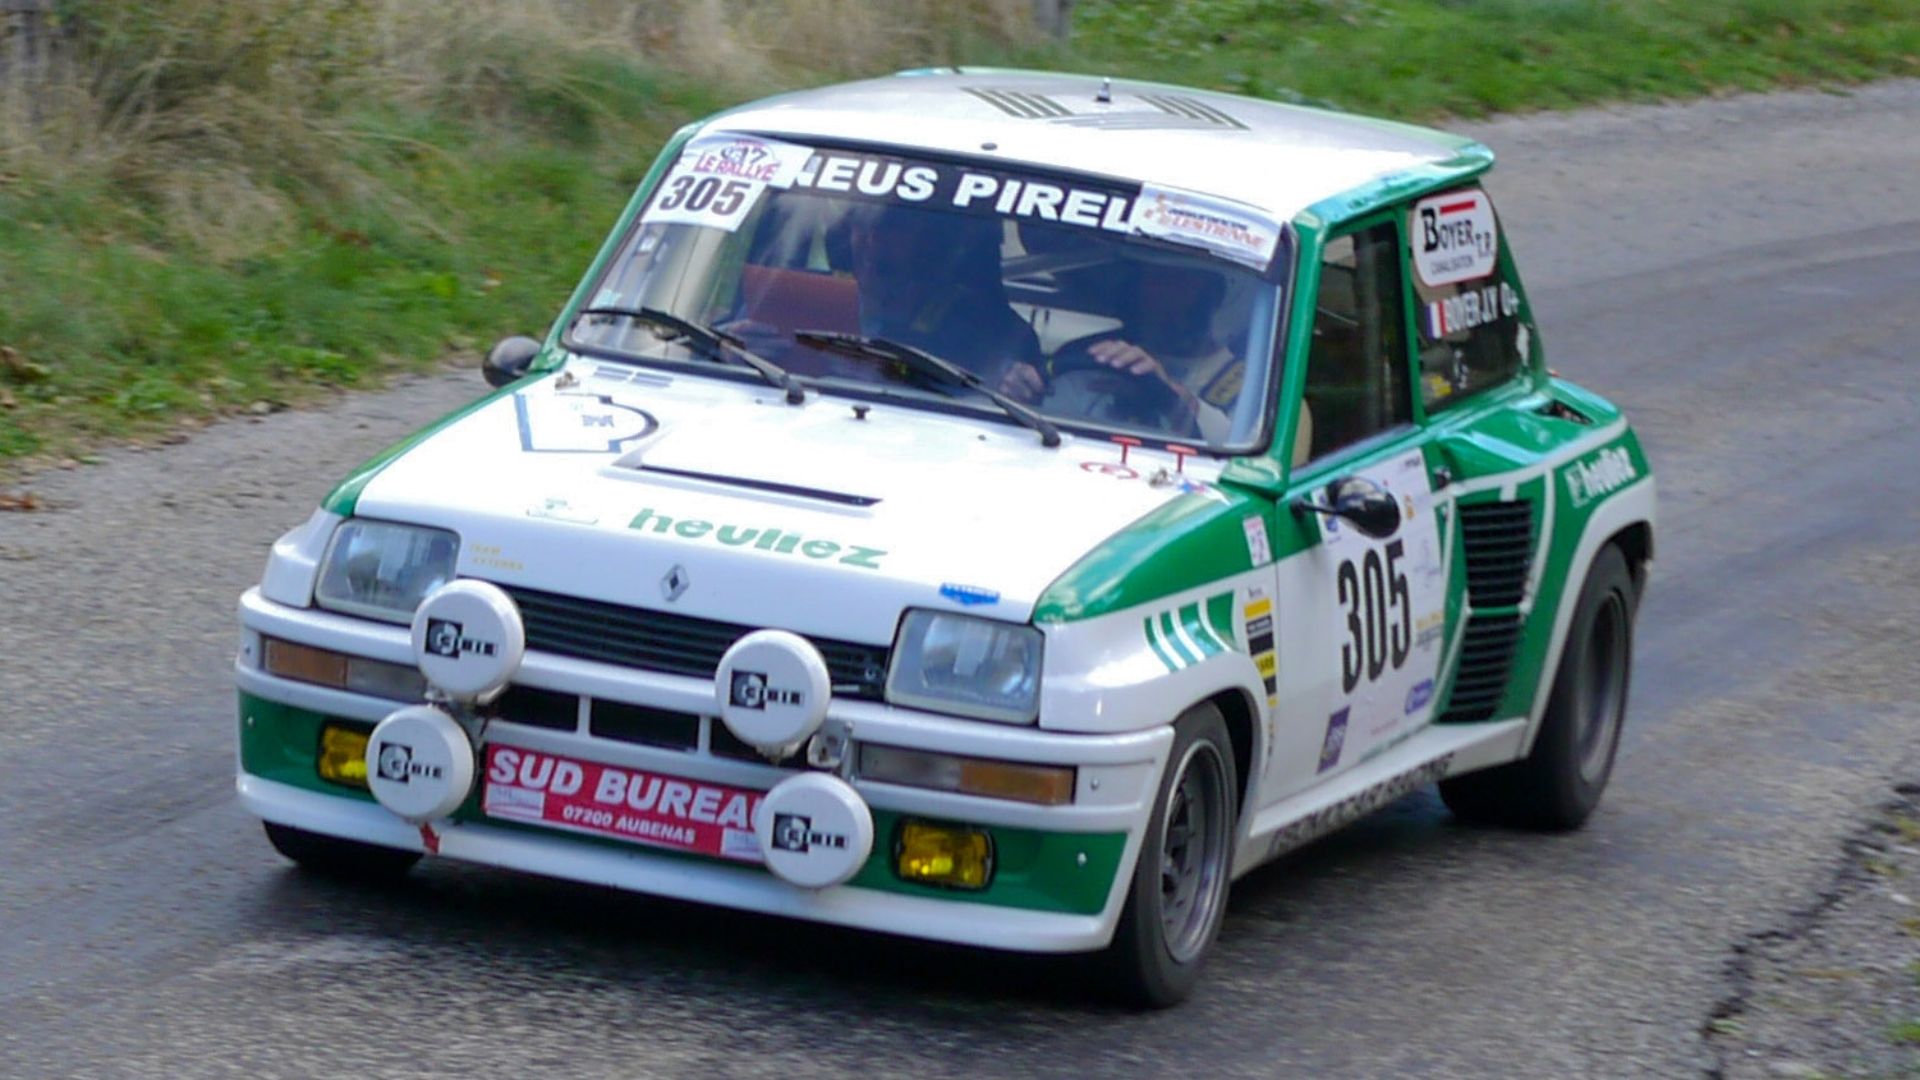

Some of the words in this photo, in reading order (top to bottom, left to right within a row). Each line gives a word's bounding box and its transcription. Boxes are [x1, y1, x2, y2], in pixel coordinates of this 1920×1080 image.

[659, 175, 751, 217] 305
[1337, 538, 1412, 694] 305
[489, 750, 584, 796] SUD
[594, 768, 768, 831] BUREA
[562, 804, 612, 827] 07200
[615, 815, 697, 845] AUBENAS
